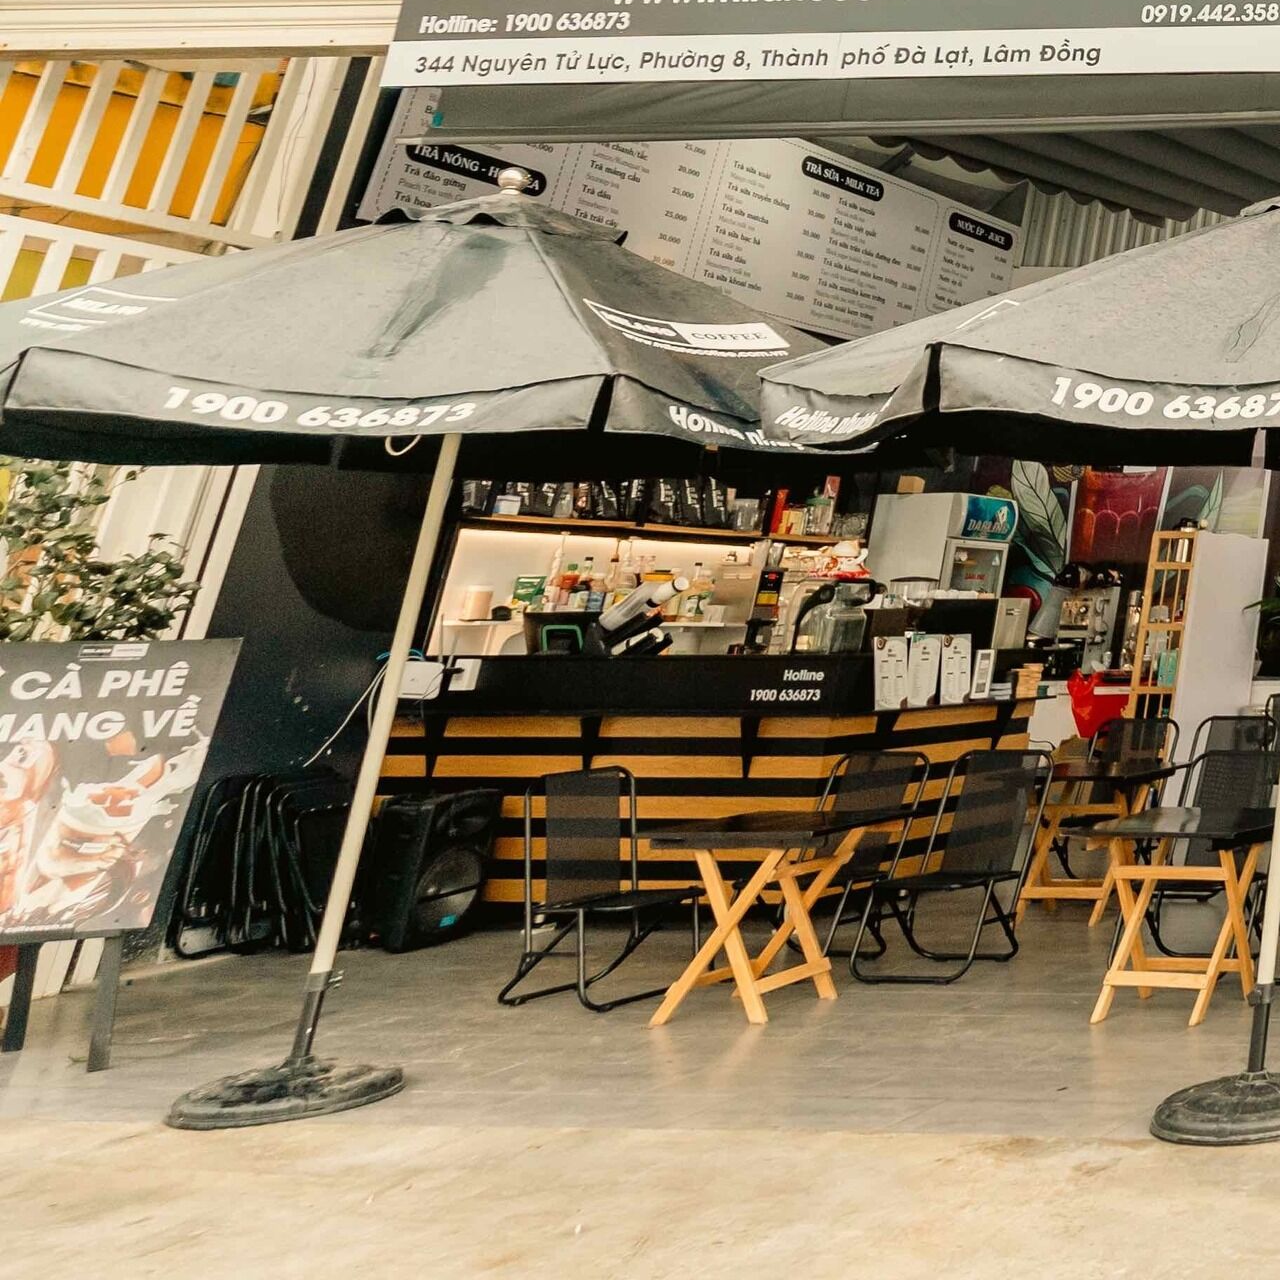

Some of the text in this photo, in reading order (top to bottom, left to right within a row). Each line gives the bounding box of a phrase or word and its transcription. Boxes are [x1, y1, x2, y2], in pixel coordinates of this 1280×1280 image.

[418, 12, 630, 33] Hotline: 1900 636873
[1140, 2, 1280, 24] 0919.442.358
[414, 37, 1102, 76] 344 Nguyên Tử Lực, Phường 8, Thành phố Đà Lạt, Lâm Đồng
[404, 164, 420, 176] Trà
[442, 152, 480, 172] NÓNG
[590, 160, 603, 170] Trà
[582, 184, 595, 195] Trà
[806, 161, 822, 175] TRÀ
[844, 177, 865, 192] MILK
[866, 184, 880, 198] TEA
[691, 331, 768, 341] COFFEE
[1051, 376, 1154, 416] 1900
[164, 387, 476, 428] 1900 636873
[10, 660, 191, 700] CÀ PHÊ
[783, 669, 825, 681] Hotline
[750, 689, 820, 701] 1900 636873
[143, 694, 202, 738] VỀ
